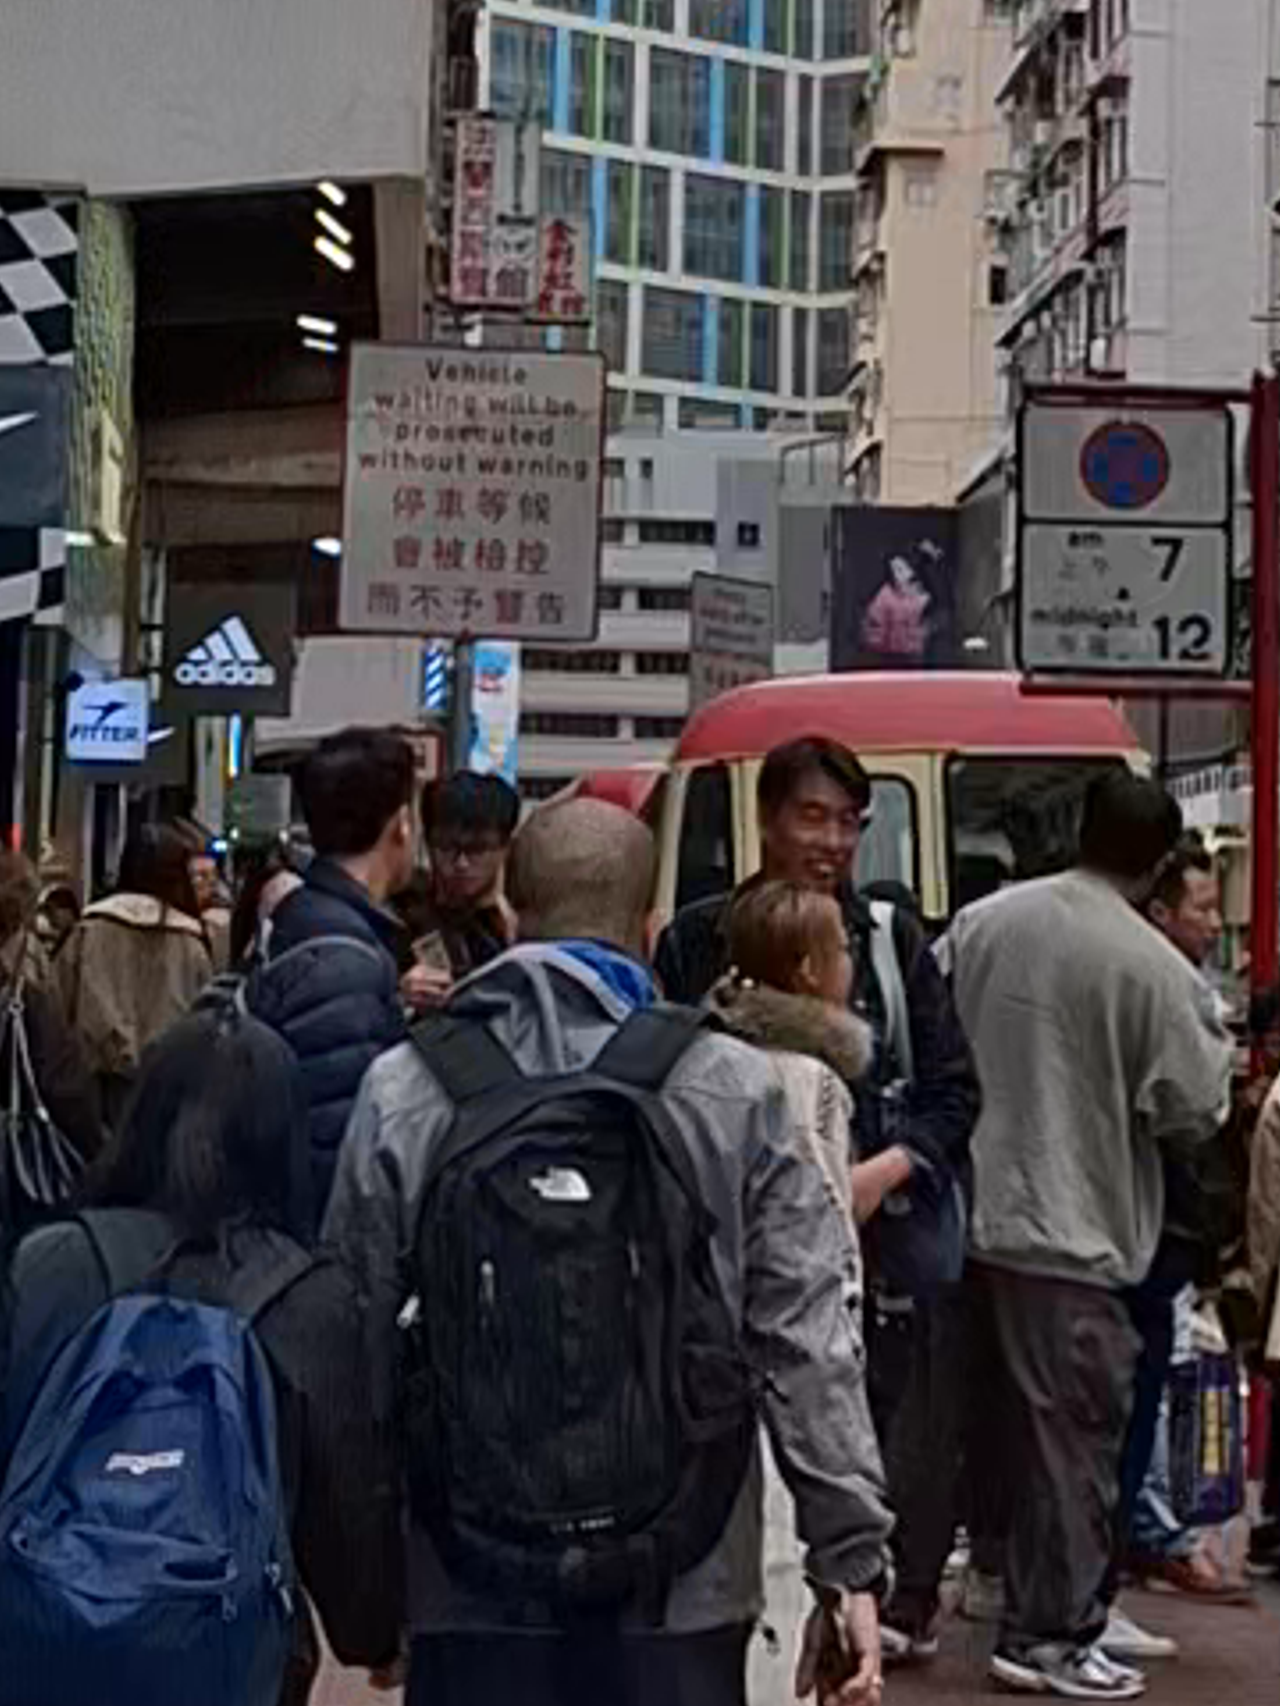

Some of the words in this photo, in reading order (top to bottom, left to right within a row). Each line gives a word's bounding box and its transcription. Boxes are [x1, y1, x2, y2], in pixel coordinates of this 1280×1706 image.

[425, 356, 528, 383] Vehicle
[375, 392, 477, 418] waiting
[488, 394, 537, 416] will
[394, 423, 555, 447] prosecuted
[359, 449, 466, 473] without
[477, 457, 590, 482] warning
[392, 486, 551, 524] 停車等候
[1151, 537, 1184, 582] 7
[366, 582, 563, 626] 而不予警告
[1030, 606, 1140, 631] midnight
[1152, 613, 1212, 661] 12
[174, 660, 276, 685] adidas
